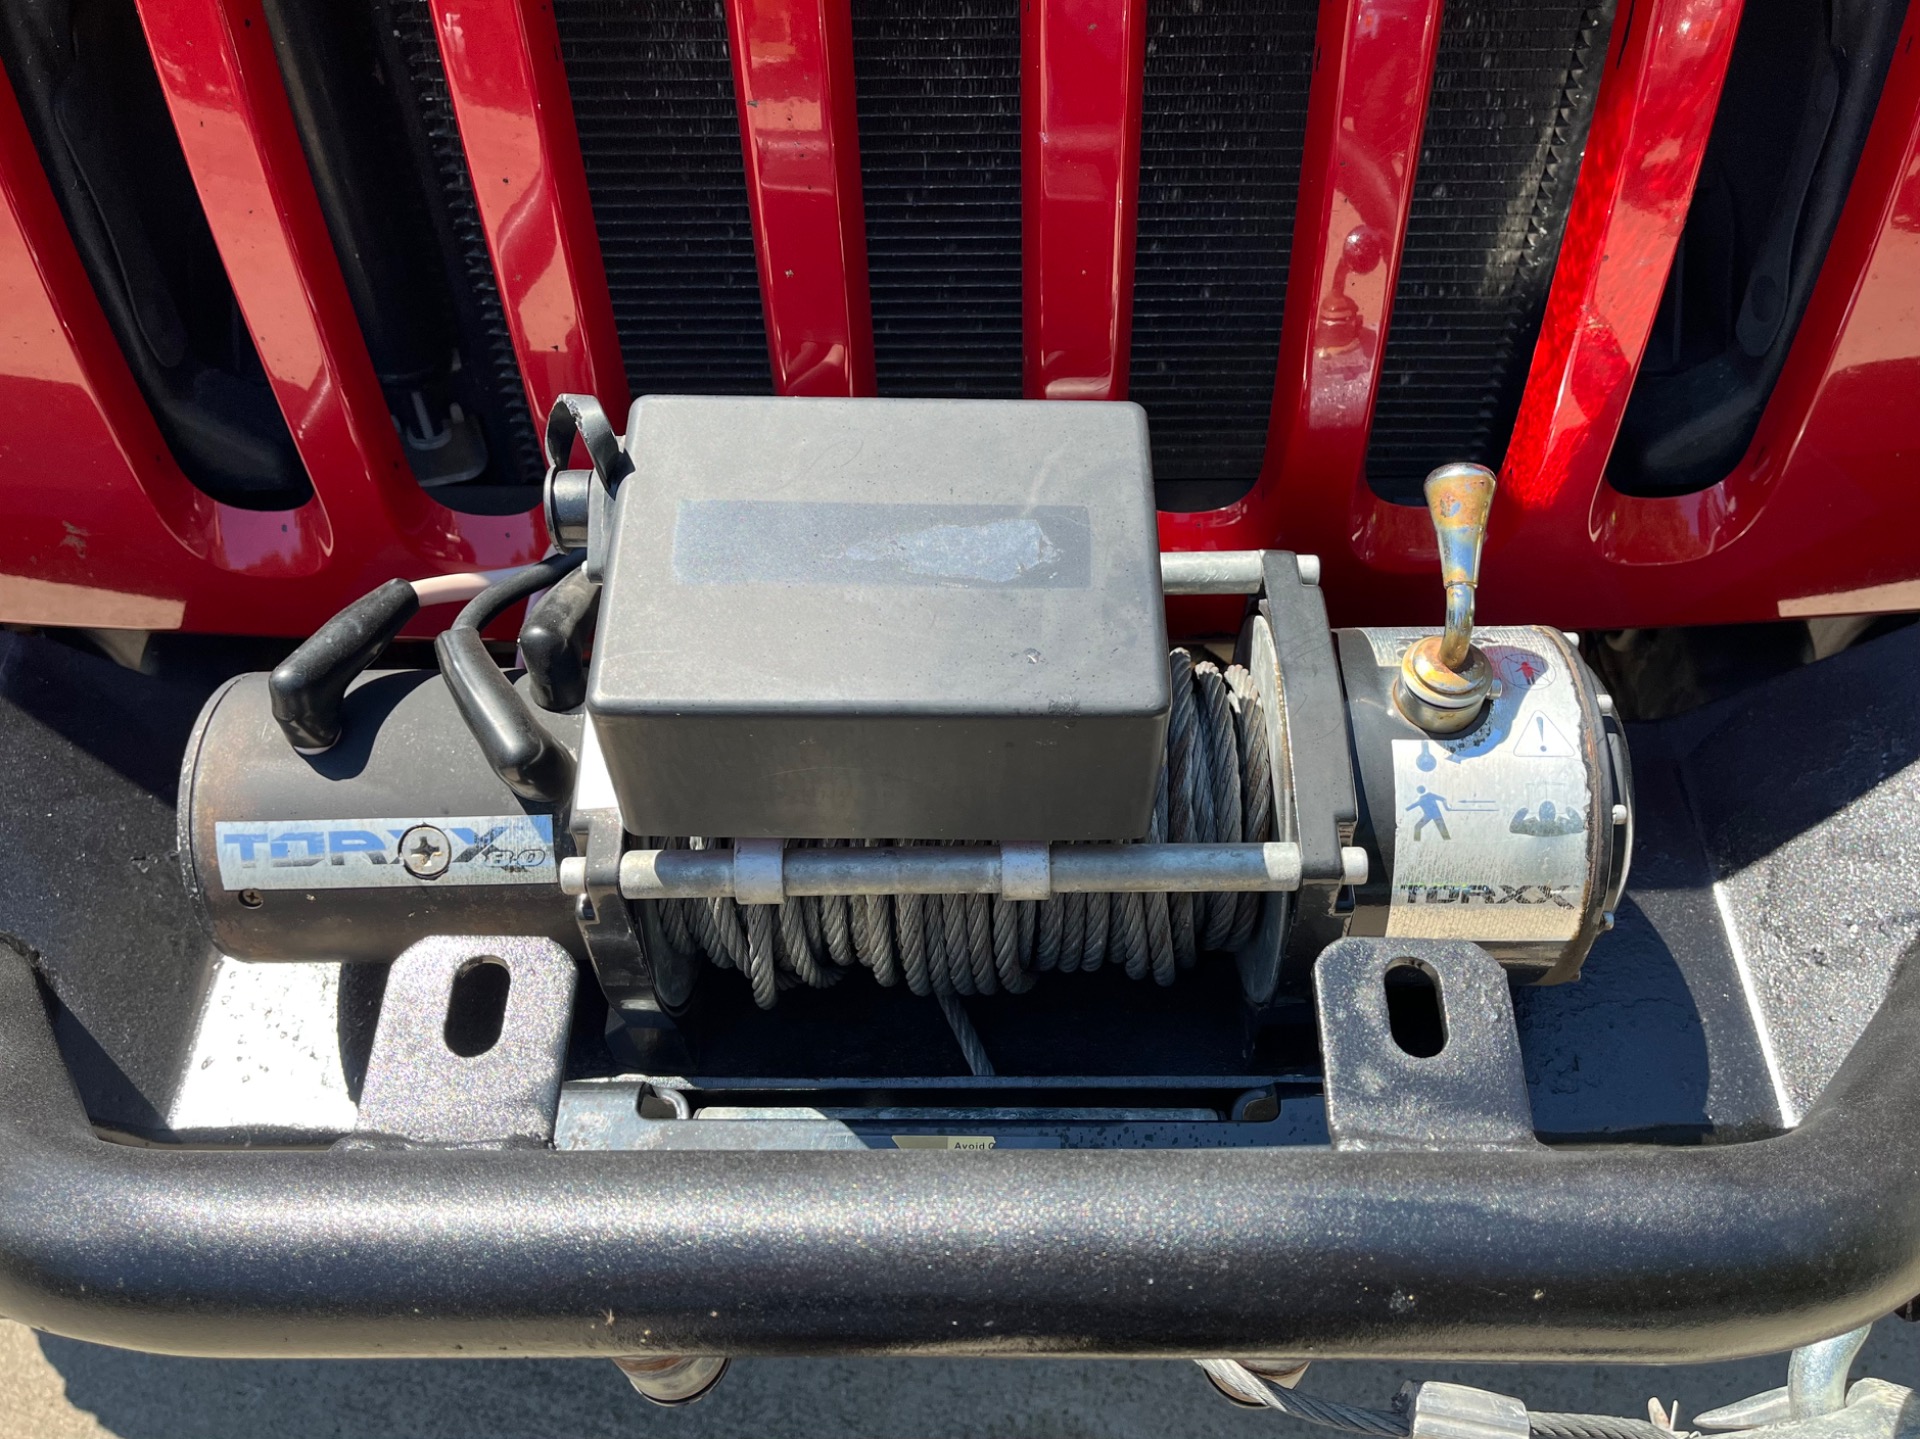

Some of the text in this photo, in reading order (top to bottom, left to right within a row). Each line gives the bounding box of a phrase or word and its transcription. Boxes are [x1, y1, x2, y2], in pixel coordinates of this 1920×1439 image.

[223, 826, 526, 870] TORX
[1400, 884, 1579, 910] TORXX
[955, 1141, 985, 1150] Avoid
